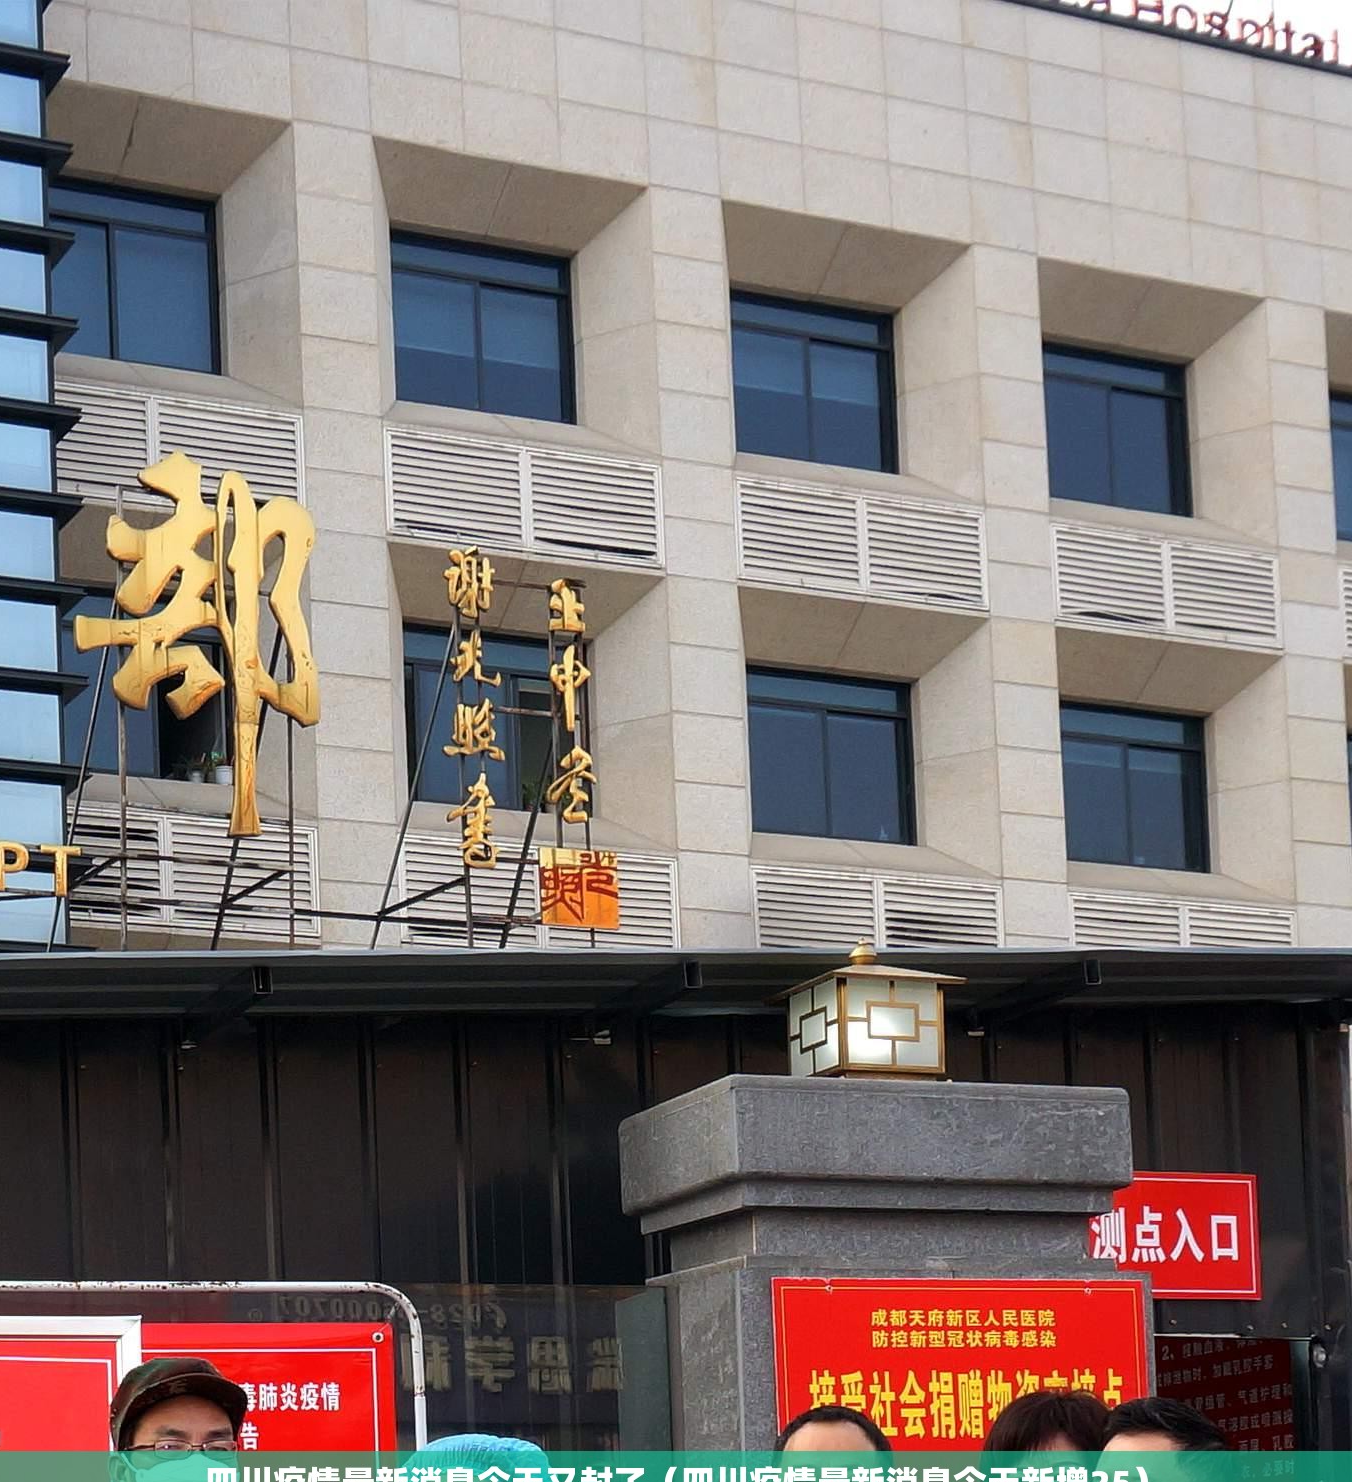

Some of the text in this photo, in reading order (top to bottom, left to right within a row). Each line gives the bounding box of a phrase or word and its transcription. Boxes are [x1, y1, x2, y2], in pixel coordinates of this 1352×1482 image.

[1091, 1205, 1239, 1265] 测点入口
[870, 1309, 1056, 1328] 成都天府新区人民医院
[871, 1330, 1056, 1349] 防控新型冠状病毒感染
[240, 1422, 260, 1450] 告
